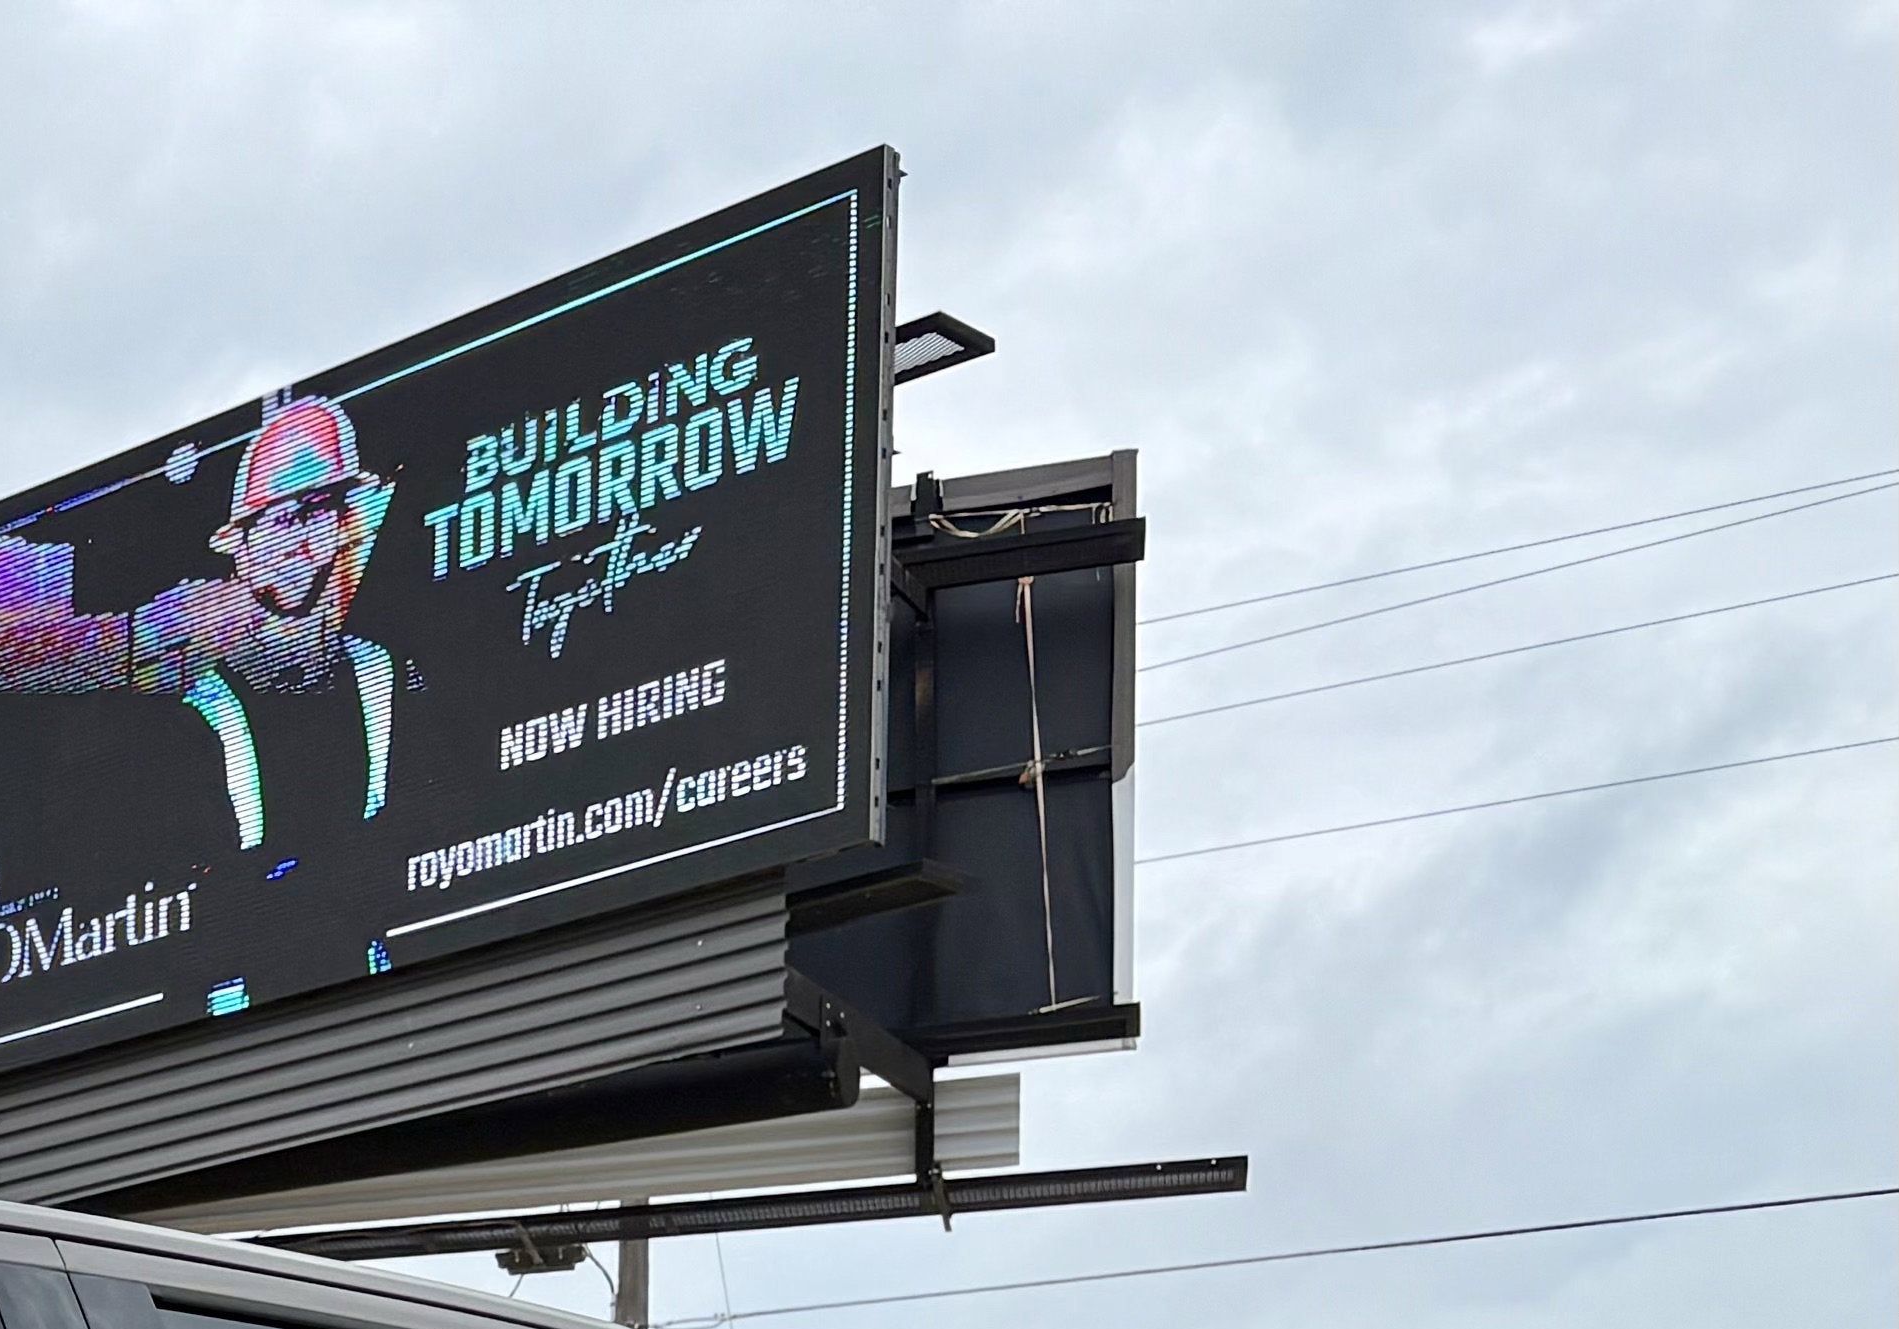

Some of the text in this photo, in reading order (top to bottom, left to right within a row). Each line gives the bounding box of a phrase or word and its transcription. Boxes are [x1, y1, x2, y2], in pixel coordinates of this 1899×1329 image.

[423, 376, 800, 581] TOMORROW
[465, 336, 758, 494] BUILDING
[505, 512, 702, 660] Together
[500, 658, 727, 771] NOW HIRING
[406, 744, 808, 891] royomartin.com/careers
